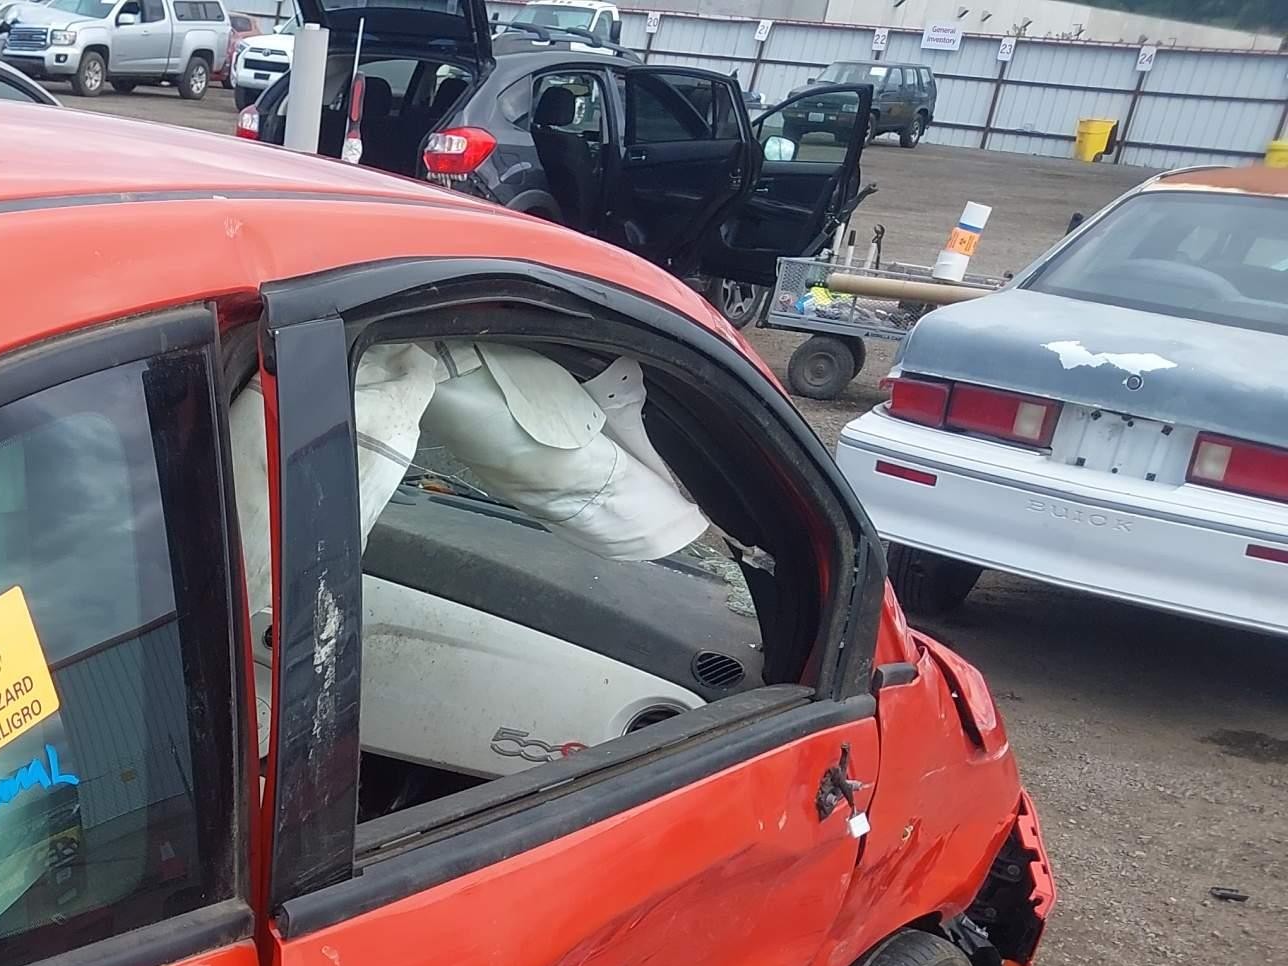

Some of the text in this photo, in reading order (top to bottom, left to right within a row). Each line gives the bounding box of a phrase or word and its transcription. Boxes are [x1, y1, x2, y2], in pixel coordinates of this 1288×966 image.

[647, 17, 659, 27] 20
[758, 24, 768, 35] 21
[932, 25, 956, 34] General
[873, 34, 886, 45] 22
[999, 43, 1012, 54] 23
[1139, 53, 1153, 64] 24
[1026, 499, 1133, 532] BUICK
